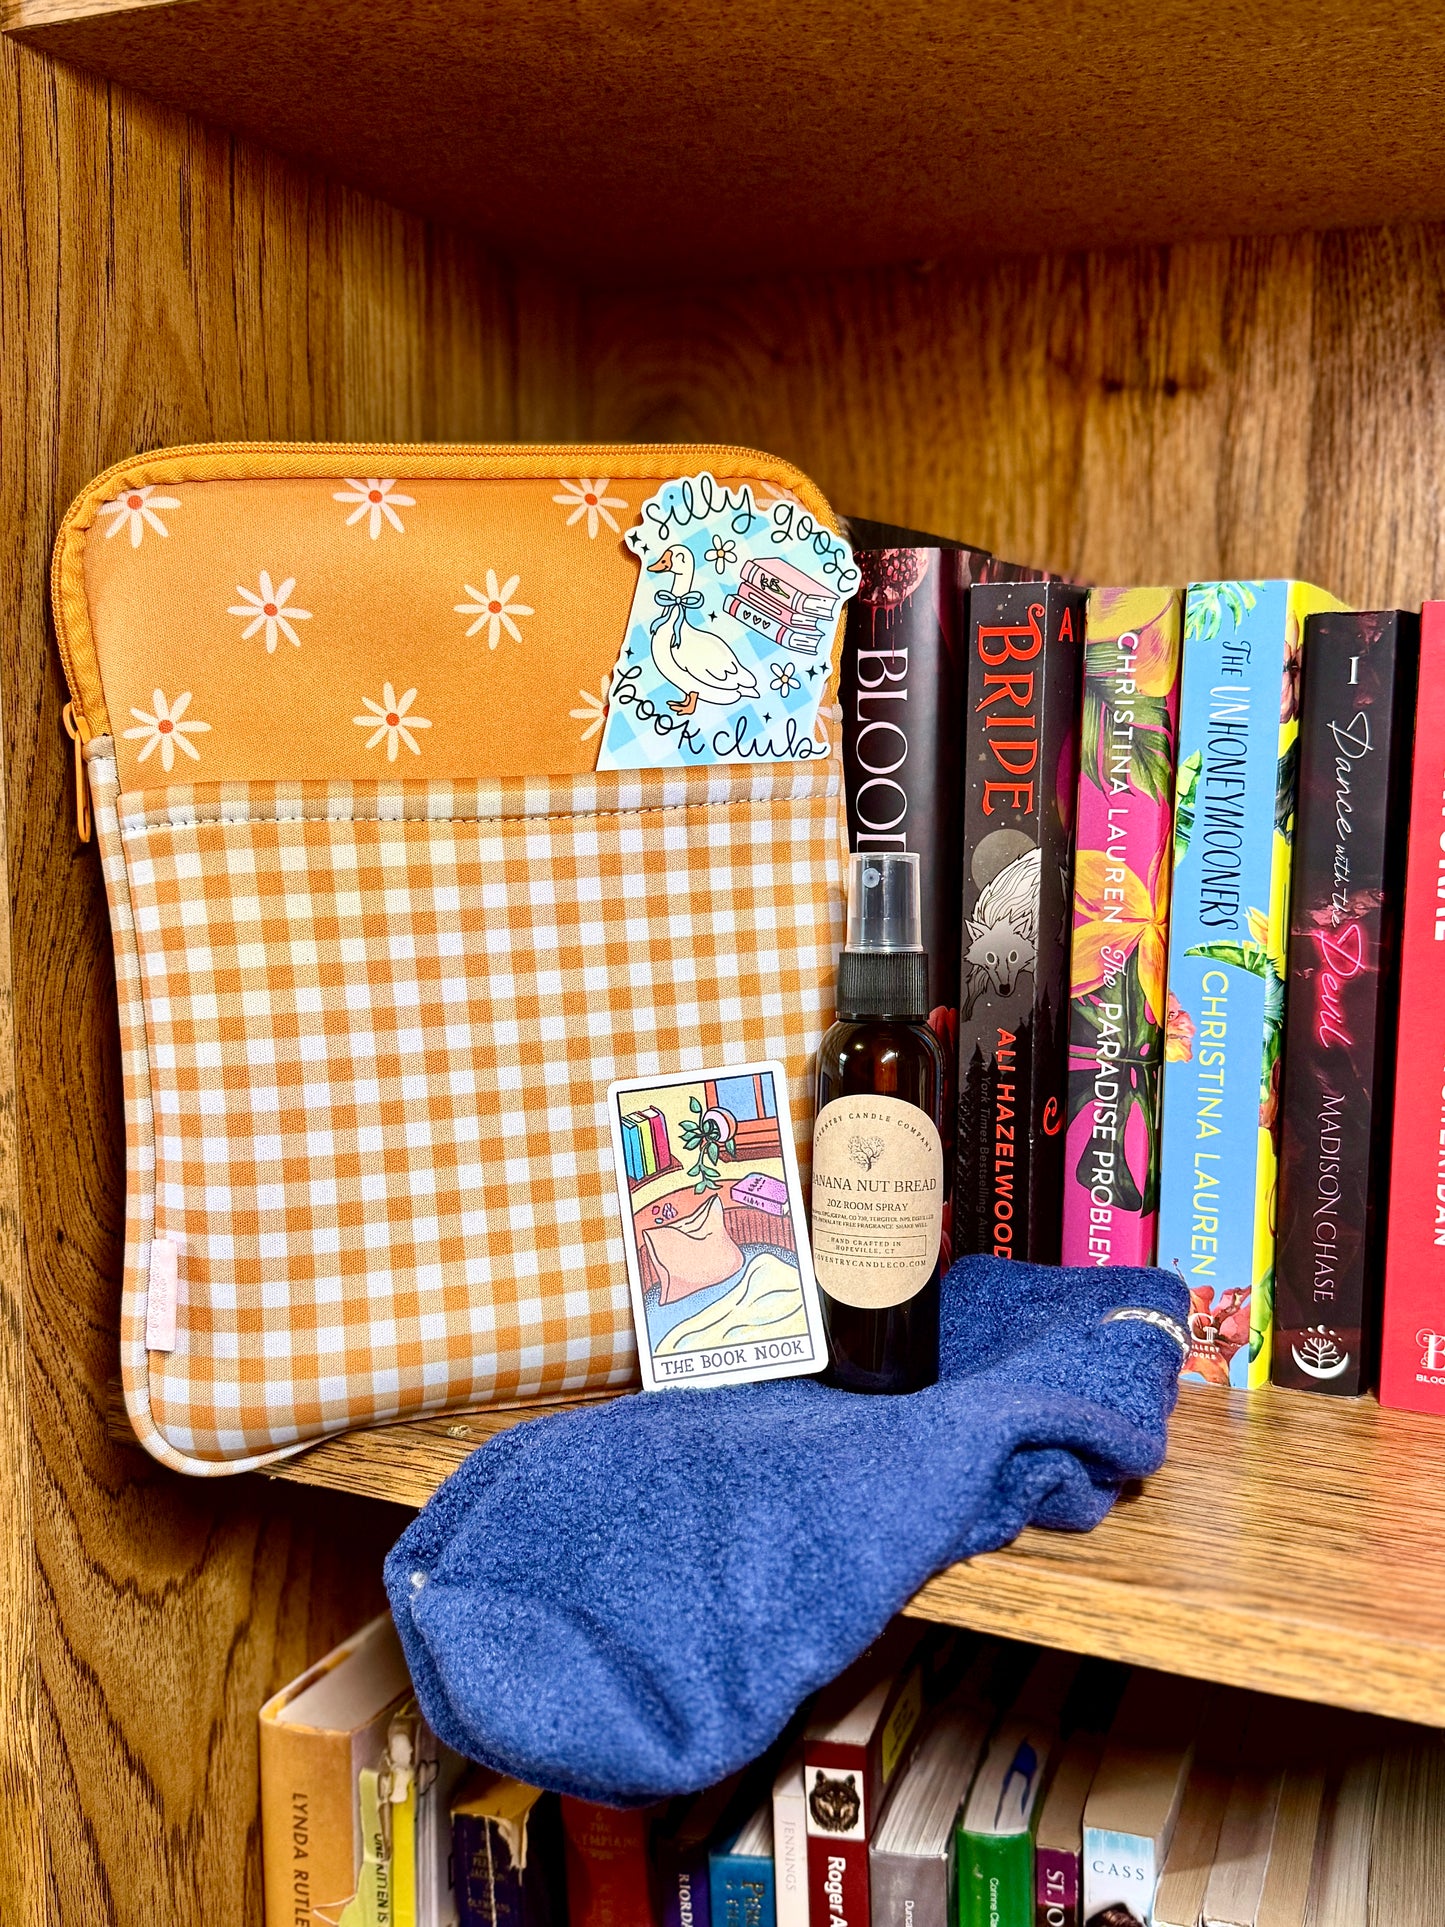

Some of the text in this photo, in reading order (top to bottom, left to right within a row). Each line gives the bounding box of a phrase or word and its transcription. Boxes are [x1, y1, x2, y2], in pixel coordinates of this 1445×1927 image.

[646, 475, 858, 592] silly goose
[613, 665, 828, 759] book club
[975, 602, 1045, 815] BRIDE
[1101, 632, 1139, 923] CHRISTINA LAUREN
[1200, 685, 1251, 931] UNHONEYMOONERS
[1315, 710, 1374, 1049] Dance with the Devil
[1100, 944, 1127, 990] The
[996, 1027, 1017, 1071] ALI
[1093, 1001, 1123, 1141] PARADISE
[981, 1077, 991, 1103] York
[849, 1112, 891, 1122] CANDLE
[897, 1120, 933, 1152] COMPANY
[979, 1108, 991, 1144] Times
[1191, 970, 1228, 1277] CHRISTINA LAUREN
[844, 1201, 873, 1211] ROOM
[875, 1202, 909, 1212] SPRAY
[856, 1179, 890, 1193] NUT
[894, 1178, 937, 1193] BREAD
[975, 1147, 990, 1214] Bestselling
[1313, 1094, 1346, 1302] MADISON CHASE
[830, 1237, 850, 1245] HAND
[853, 1239, 890, 1247] CRAFTED
[661, 1340, 804, 1376] THE BOOK NOOK
[292, 1792, 309, 1860] LYNDA
[782, 1820, 797, 1892] JENNINGS
[824, 1856, 847, 1914] Roger
[1046, 1868, 1065, 1895] ST.
[1092, 1859, 1145, 1881] CASS
